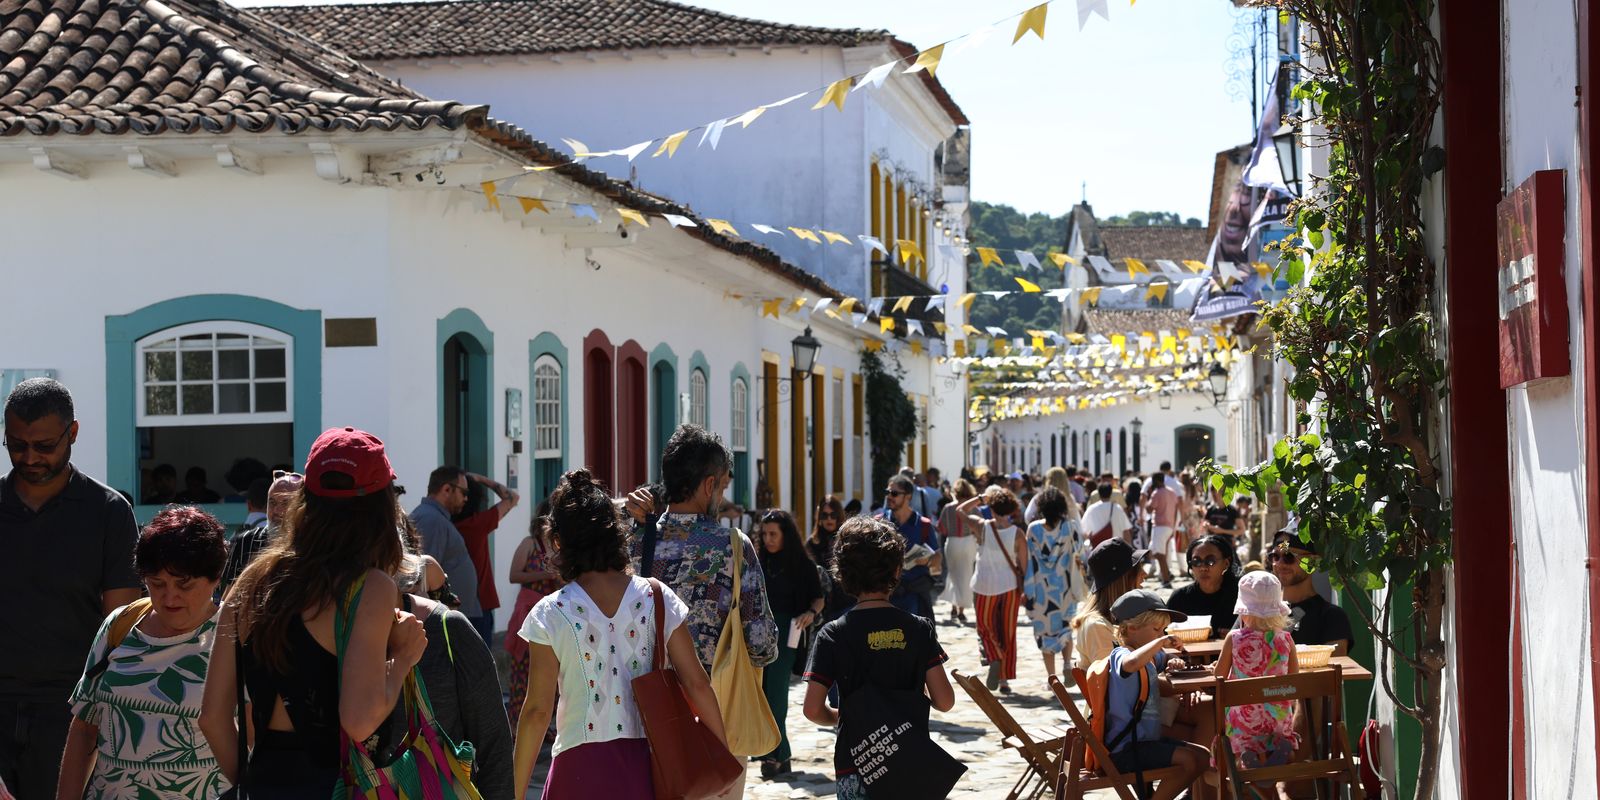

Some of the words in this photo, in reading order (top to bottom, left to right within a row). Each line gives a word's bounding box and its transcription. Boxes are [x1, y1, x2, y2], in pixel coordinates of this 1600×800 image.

[854, 732, 893, 766] carregar
[894, 721, 912, 735] um
[868, 724, 888, 744] pra
[858, 754, 884, 775] tanto
[885, 743, 899, 756] de
[864, 766, 888, 785] trem
